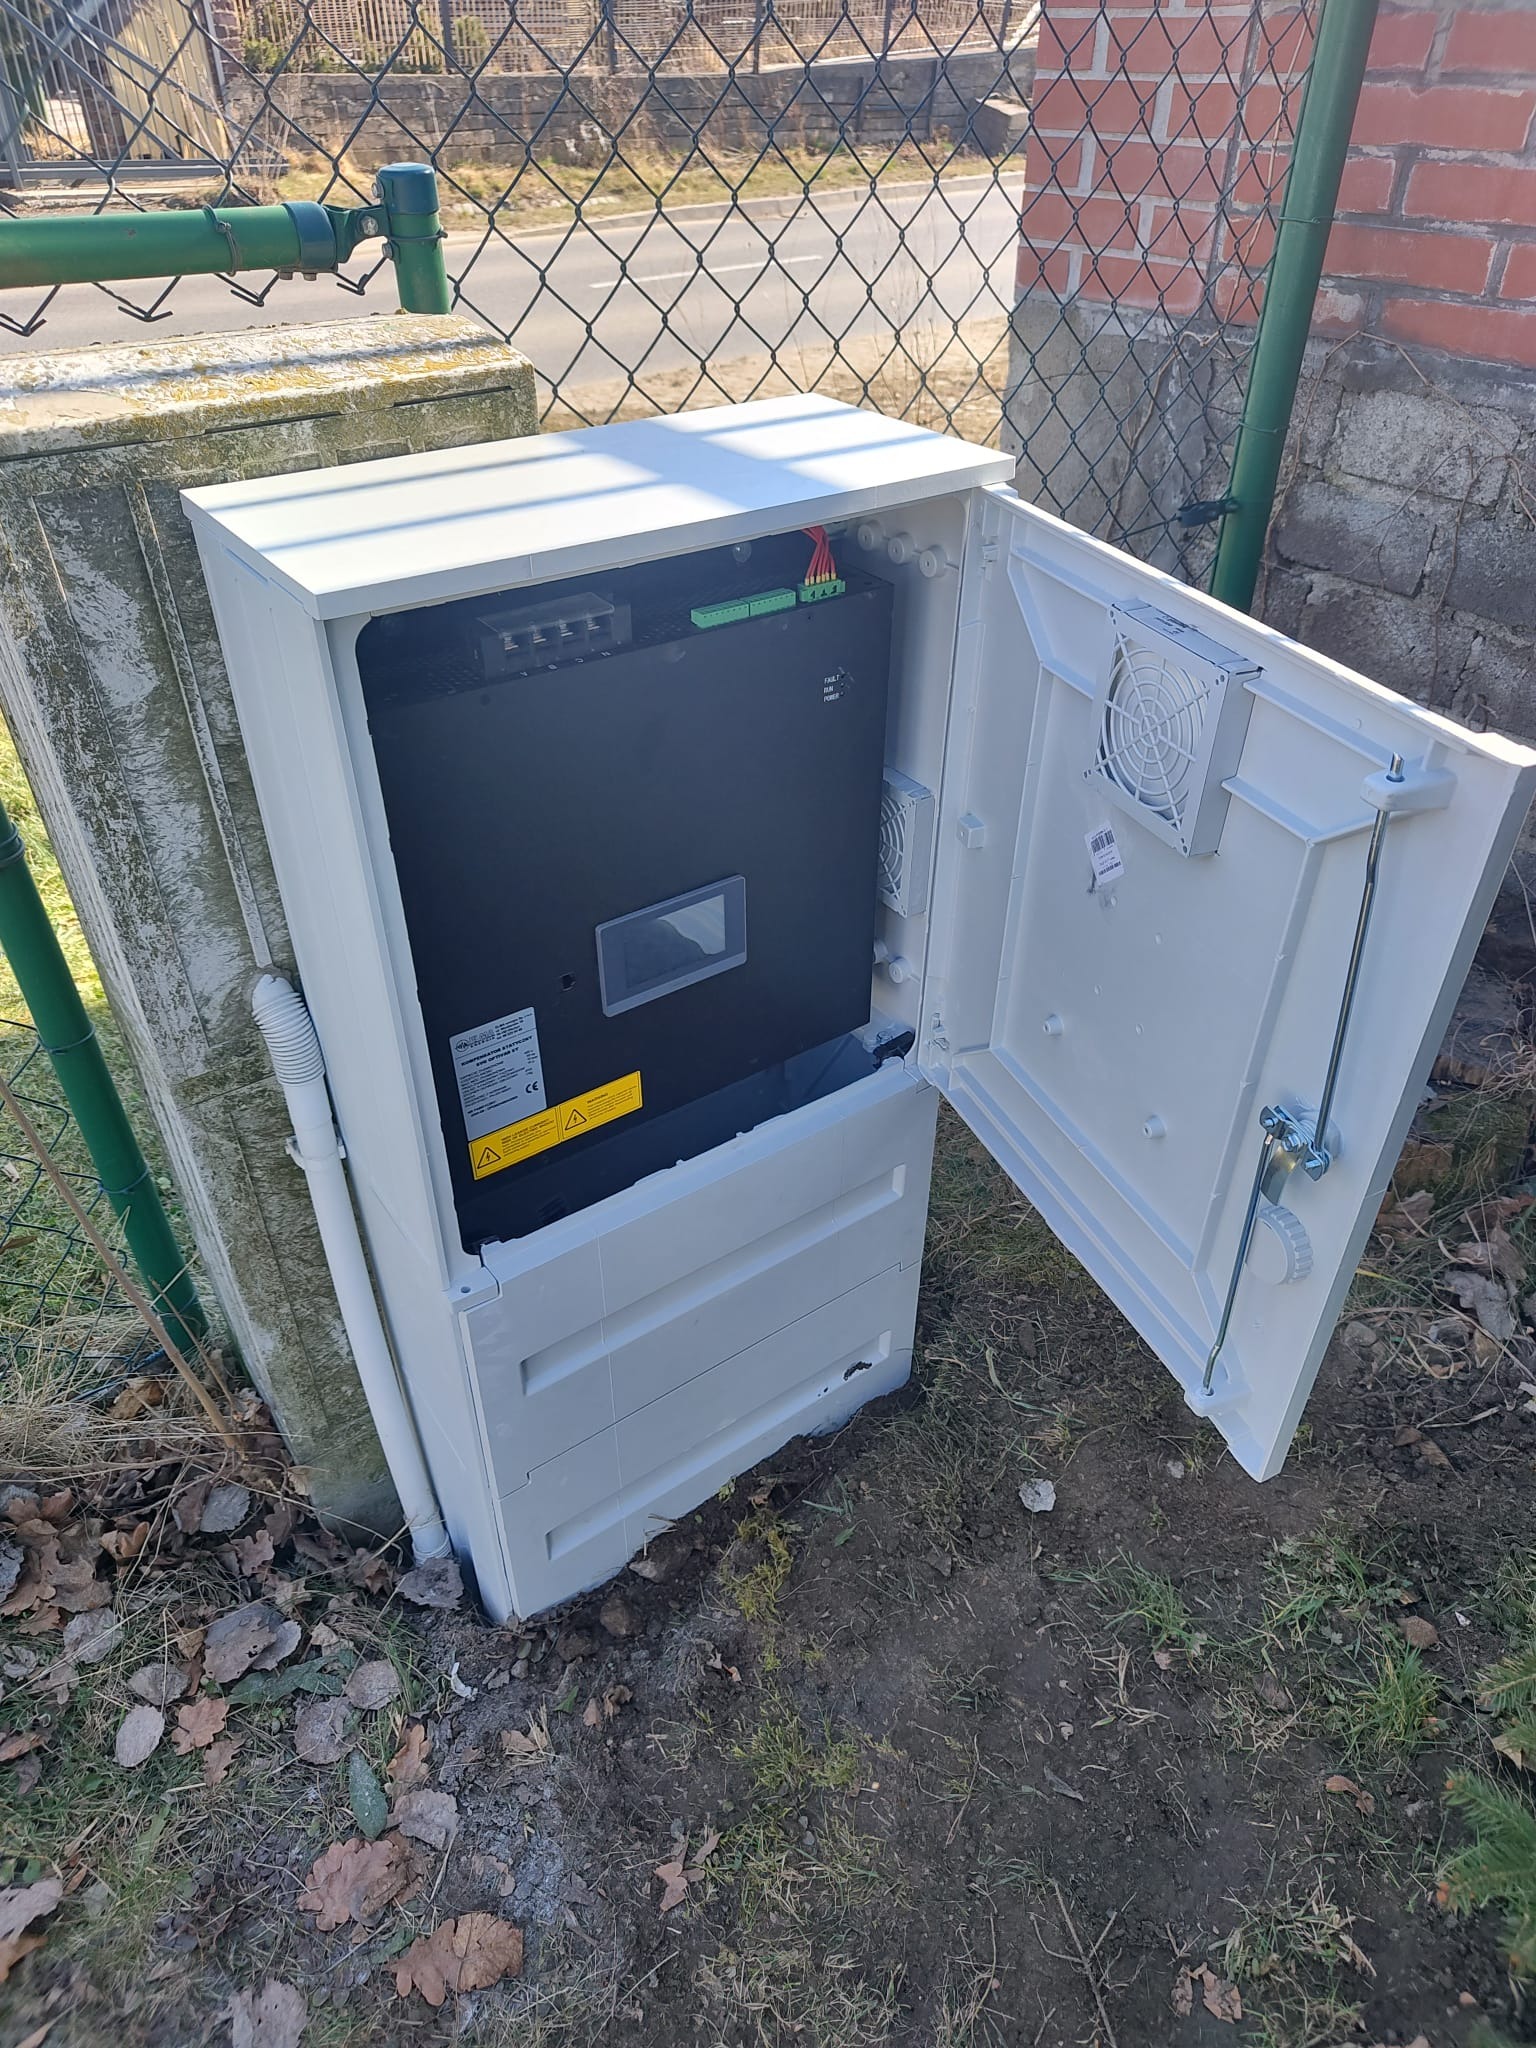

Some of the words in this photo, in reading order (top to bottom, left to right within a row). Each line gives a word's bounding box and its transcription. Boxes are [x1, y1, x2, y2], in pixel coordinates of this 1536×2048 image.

[824, 674, 840, 684] FAULT
[823, 685, 834, 694] RUN
[823, 692, 840, 702] POWER
[525, 1080, 539, 1094] CE
